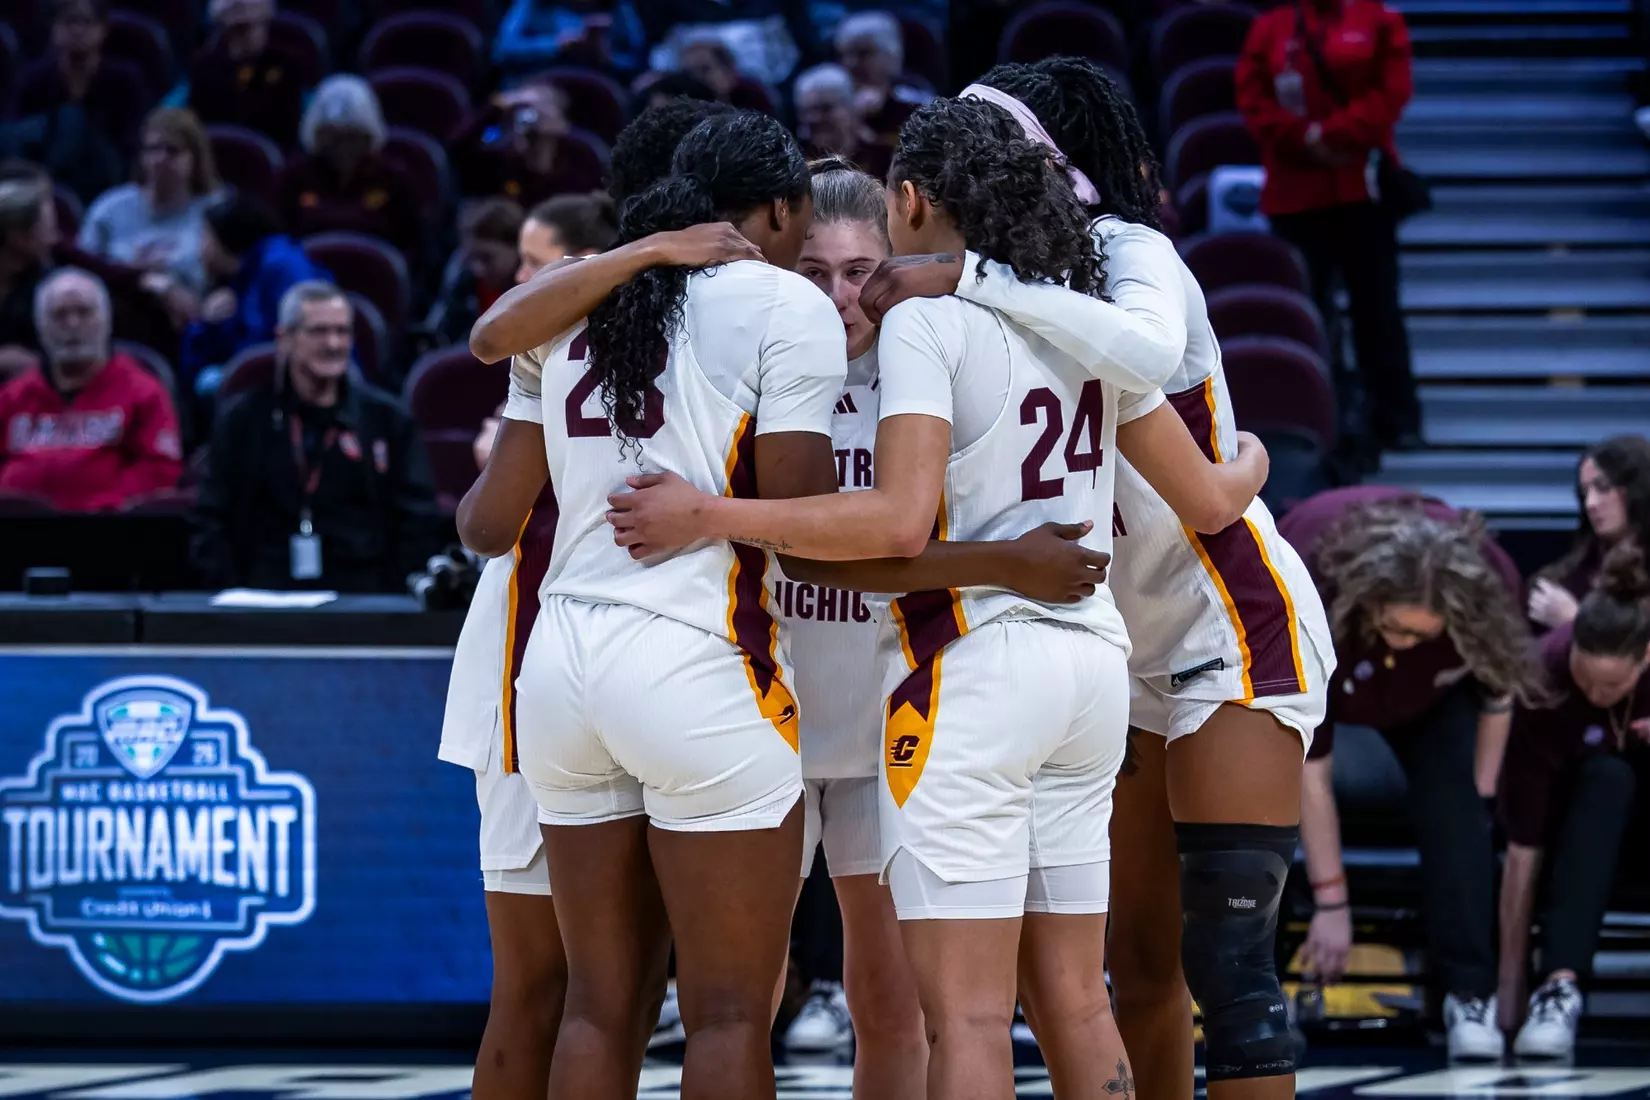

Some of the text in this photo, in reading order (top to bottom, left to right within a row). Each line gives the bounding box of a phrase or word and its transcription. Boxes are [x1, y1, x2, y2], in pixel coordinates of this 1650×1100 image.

[1019, 379, 1104, 502] 24
[107, 779, 229, 802] BASKETBALL
[3, 805, 298, 897] TOURNAMENT
